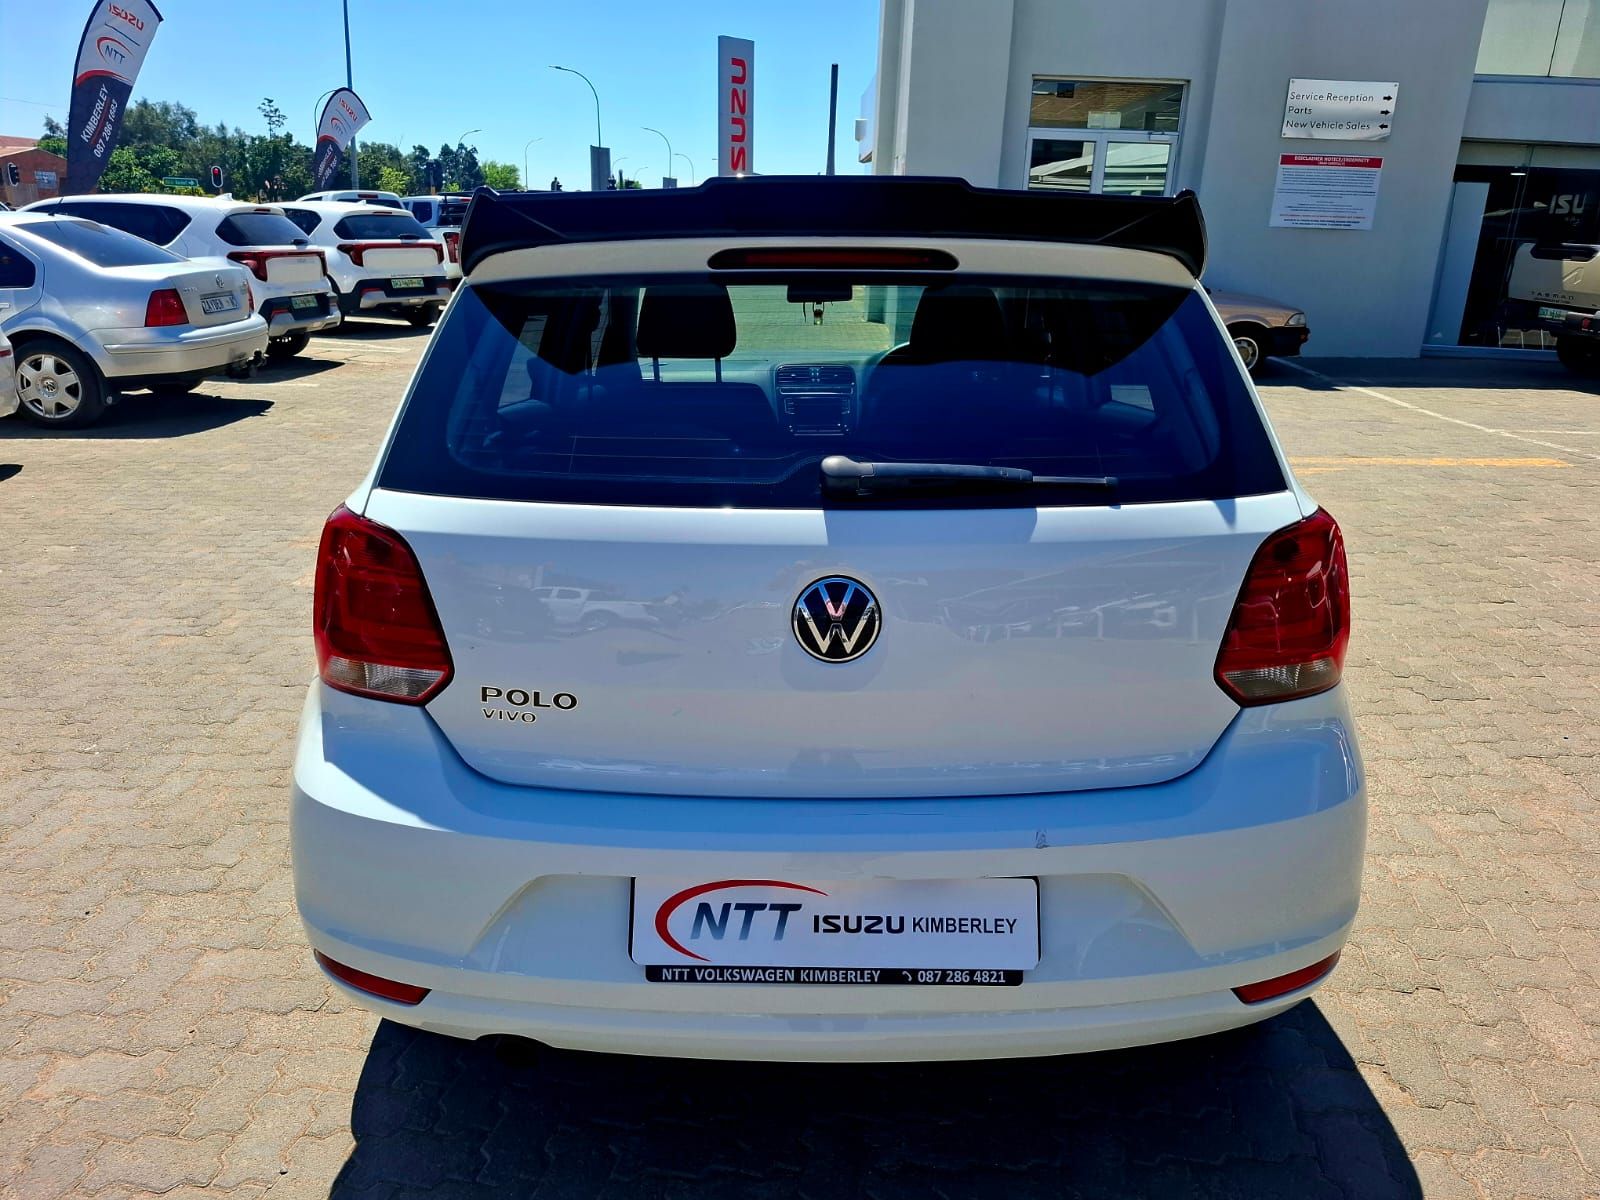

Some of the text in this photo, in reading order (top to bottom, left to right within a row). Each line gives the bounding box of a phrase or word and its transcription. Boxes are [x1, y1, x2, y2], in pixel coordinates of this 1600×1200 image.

[108, 3, 144, 31] ISUZU
[104, 45, 126, 64] NTT
[1290, 92, 1374, 103] Service Reception
[80, 83, 109, 143] KIMBERLEY
[730, 57, 746, 172] SUZU
[1288, 106, 1312, 115] Parts
[1285, 120, 1370, 130] New Vehicle Sales
[93, 139, 106, 158] 087
[102, 122, 113, 141] 286
[1548, 194, 1586, 214] ISU
[480, 686, 578, 710] POLO
[482, 709, 536, 723] VIVO
[690, 902, 1018, 941] NTT ISUZU KIMBERLEY
[662, 968, 1006, 983] NTT VOLKSWAGEN KIMBERLEY 087 286 4821
